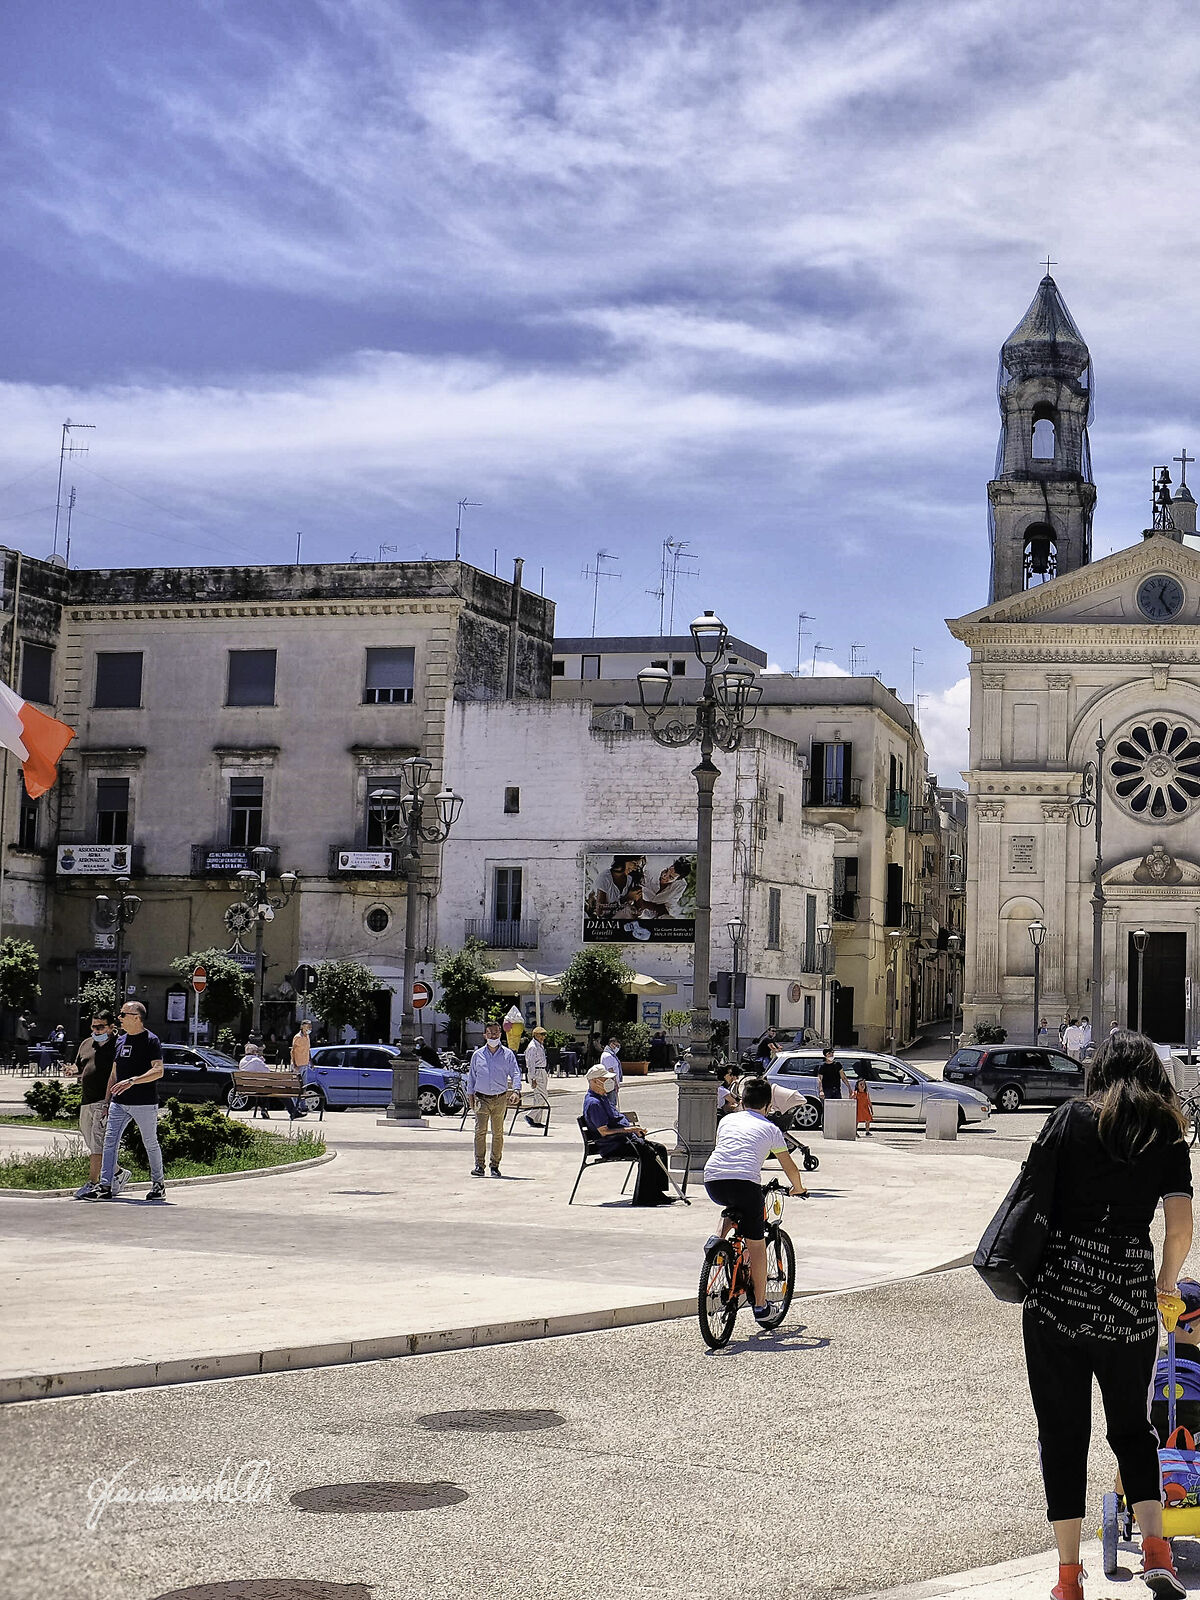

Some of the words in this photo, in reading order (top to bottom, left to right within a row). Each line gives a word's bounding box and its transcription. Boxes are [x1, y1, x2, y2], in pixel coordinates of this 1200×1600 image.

[586, 920, 620, 929] DIANA
[1069, 1234, 1086, 1247] FOR
[1087, 1240, 1110, 1254] EVER
[1063, 1259, 1094, 1277] EVER
[1098, 1269, 1122, 1285] FOR
[1131, 1289, 1148, 1299] FOR
[1092, 1312, 1115, 1323] FOR
[1104, 1324, 1132, 1335] EVER
[1126, 1332, 1141, 1343] FOR
